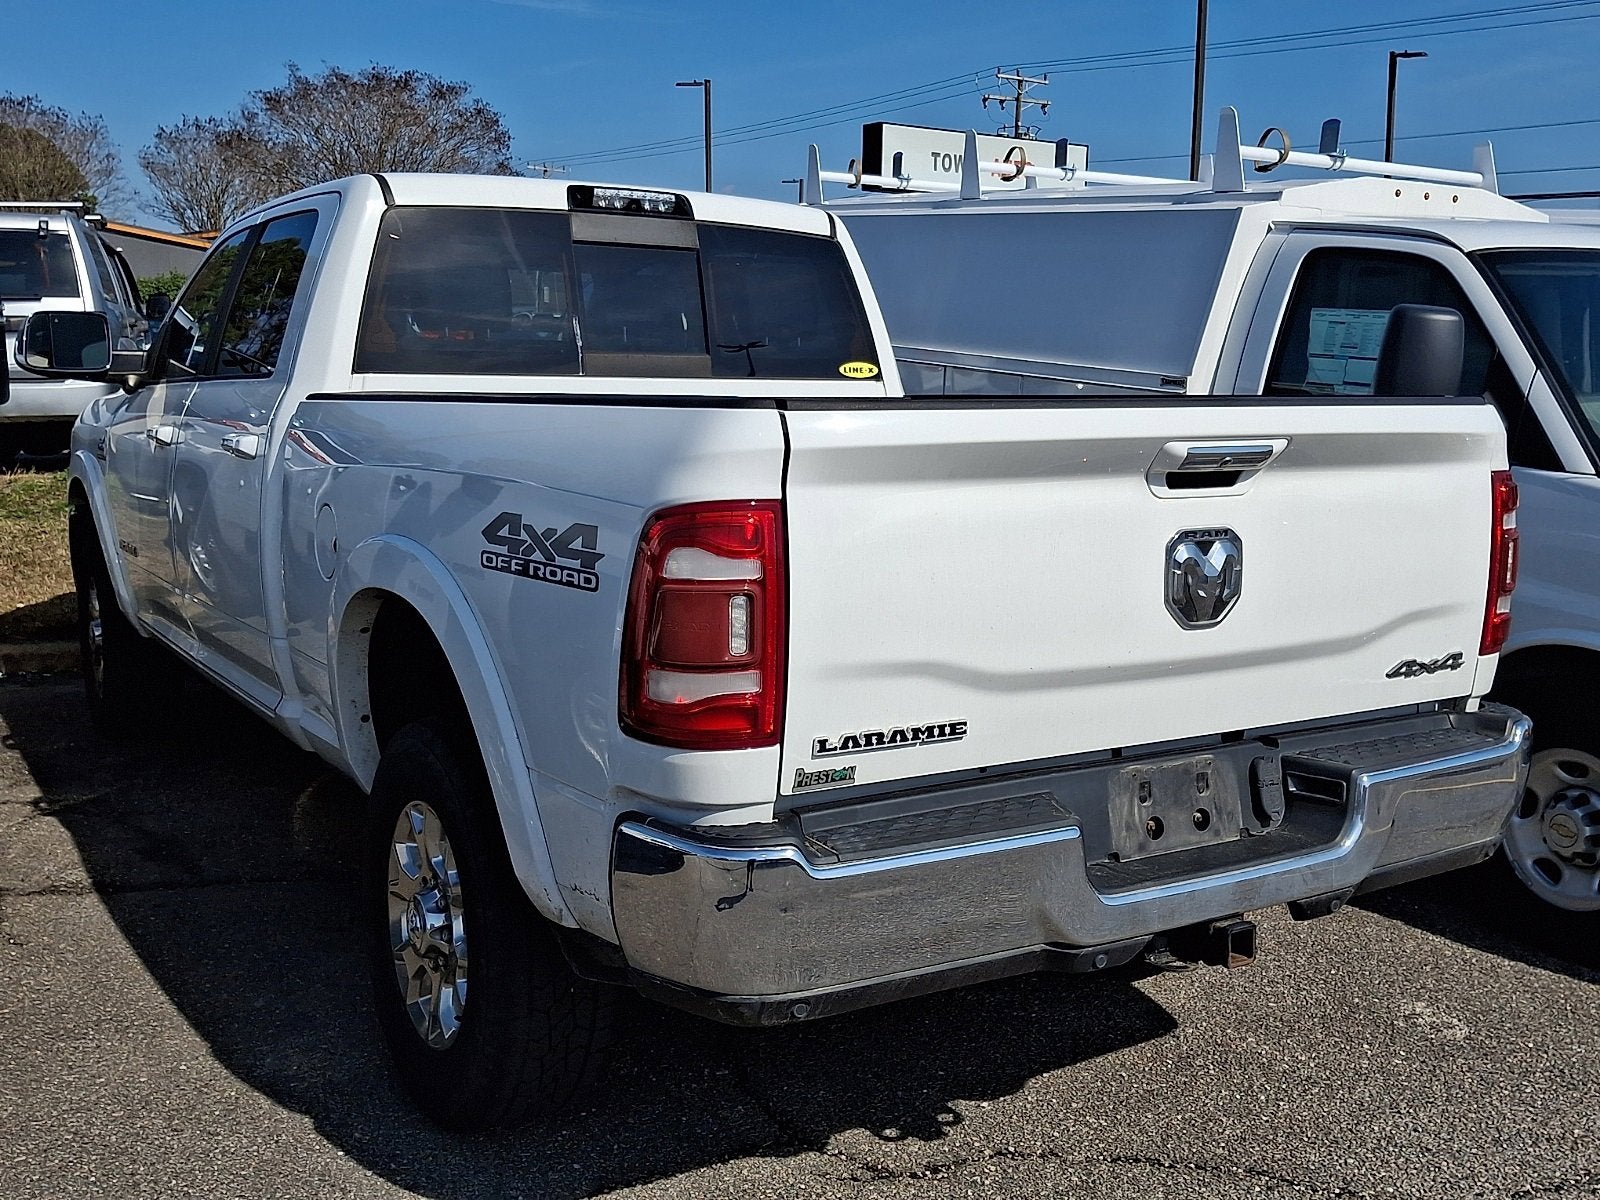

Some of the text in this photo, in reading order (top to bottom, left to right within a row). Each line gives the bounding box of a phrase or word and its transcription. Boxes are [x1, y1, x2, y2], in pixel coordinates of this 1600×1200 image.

[843, 366, 874, 374] LINE-X
[1184, 529, 1229, 539] RAM
[482, 552, 598, 589] OFF ROAD
[812, 719, 969, 757] LARAMIE
